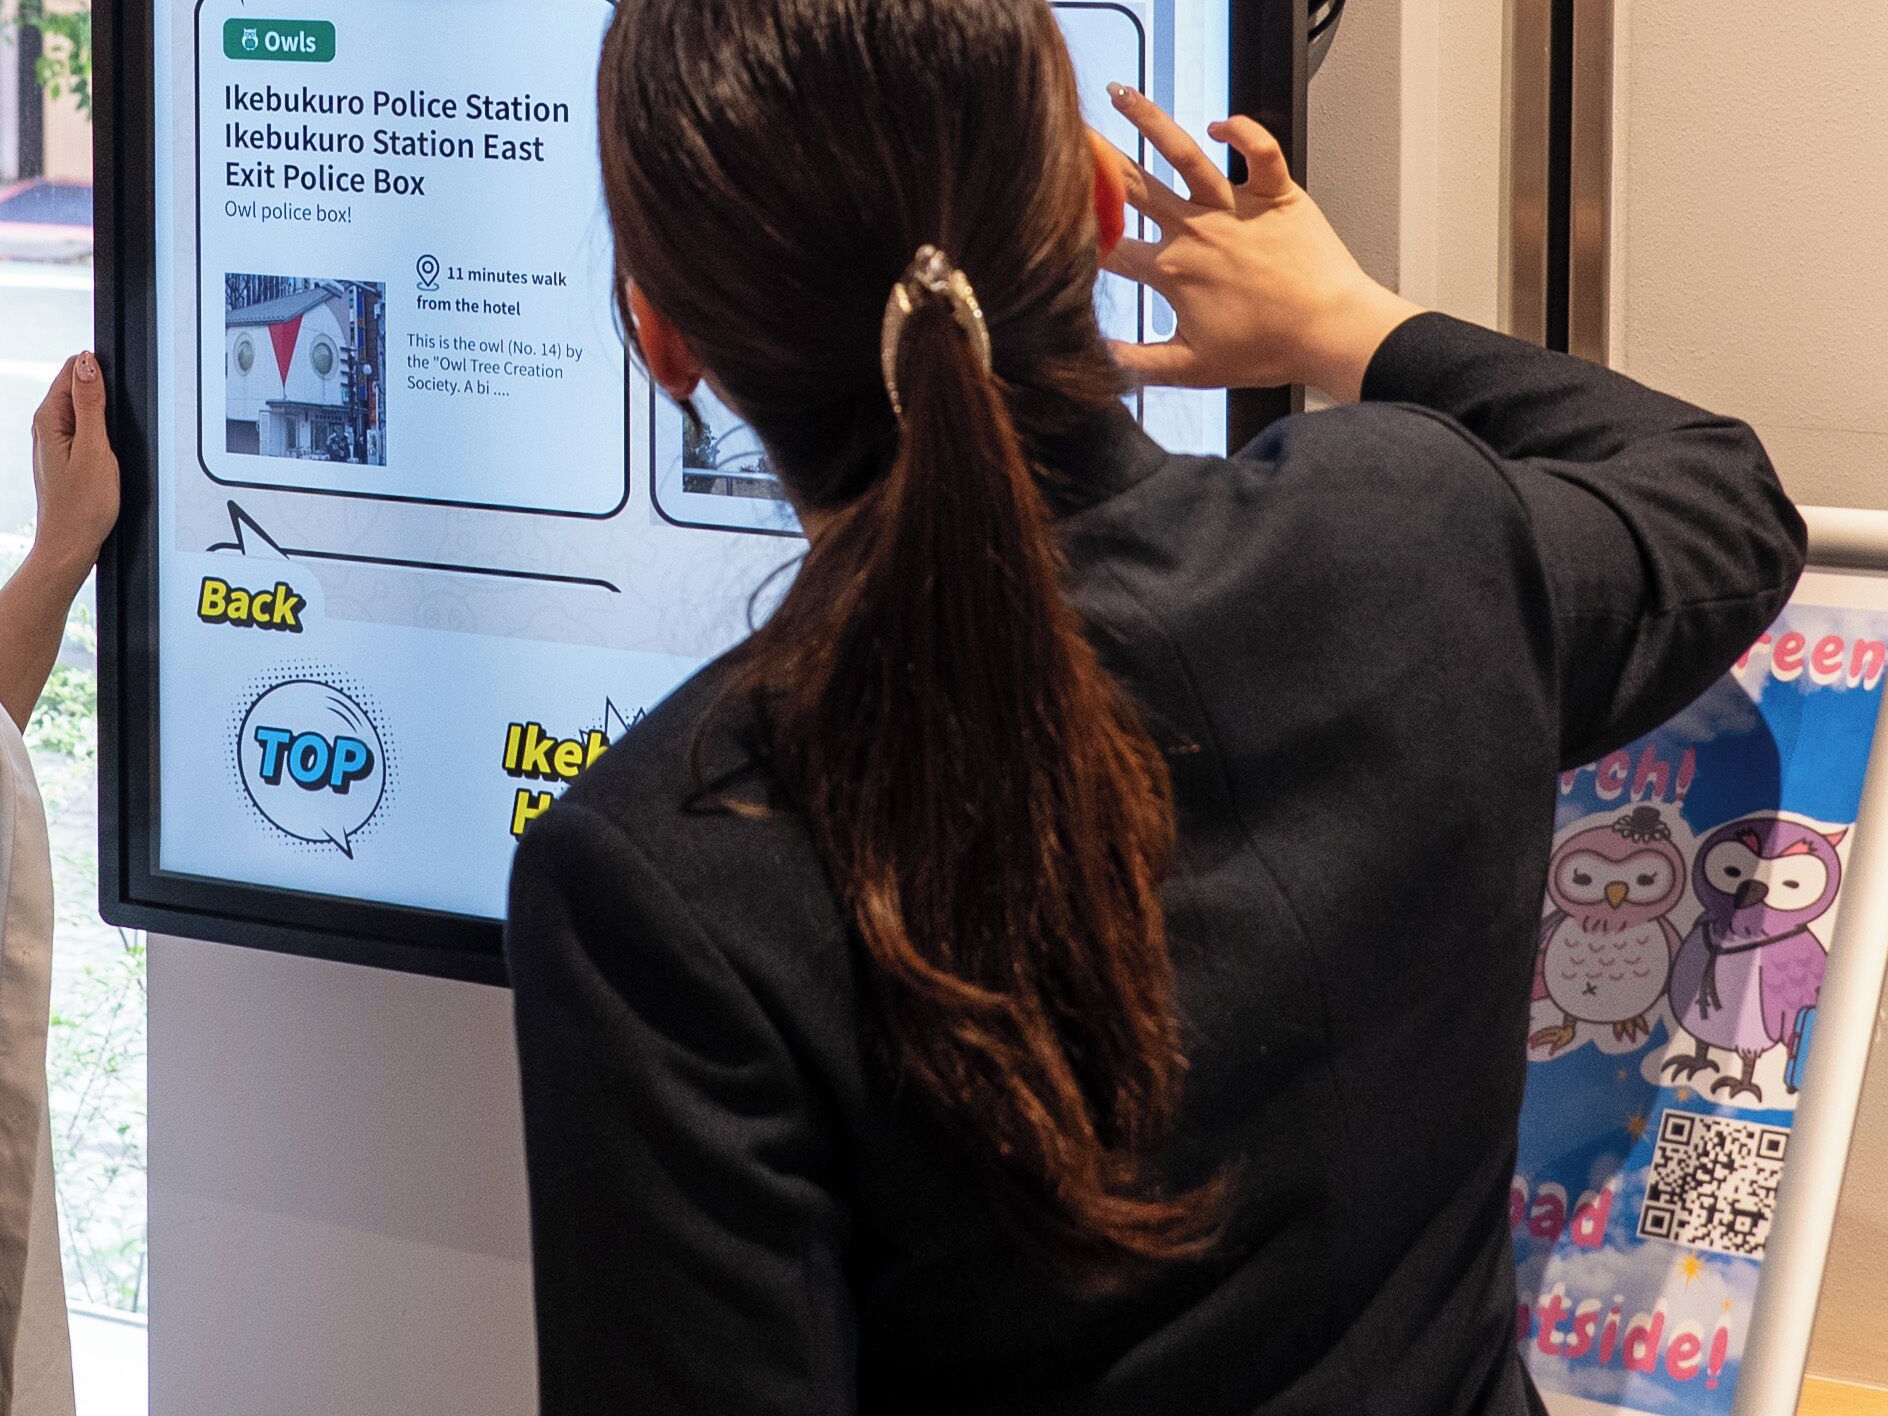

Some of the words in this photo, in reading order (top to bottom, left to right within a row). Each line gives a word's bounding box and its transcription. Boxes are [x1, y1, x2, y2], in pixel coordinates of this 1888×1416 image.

[264, 30, 316, 54] Owls
[225, 85, 365, 116] Ikebukuro
[373, 90, 458, 120] Police
[466, 94, 570, 123] Station
[225, 123, 365, 154] Ikebukuro
[373, 129, 474, 160] Station
[484, 134, 545, 163] East
[225, 161, 275, 190] Exit
[283, 165, 365, 194] Police
[374, 168, 425, 197] Box
[225, 199, 257, 219] Owl
[261, 201, 312, 225] police
[316, 203, 352, 224] box!
[447, 266, 464, 280] 11
[468, 266, 529, 284] minutes
[533, 270, 567, 287] walk
[416, 295, 451, 312] from
[455, 297, 480, 314] the
[483, 298, 521, 317] hotel
[407, 333, 435, 348] This
[439, 335, 449, 349] is
[454, 336, 476, 351] the
[479, 339, 504, 353] owl
[509, 339, 536, 357] (No.
[542, 343, 561, 359] 14)
[566, 344, 582, 361] by
[407, 355, 429, 369] the
[434, 356, 466, 372] "Owl
[470, 359, 500, 374] Tree
[504, 362, 563, 378] Creation
[407, 376, 460, 396] Society.
[464, 380, 473, 393] A
[478, 381, 489, 394] bi
[199, 578, 305, 631] Back
[254, 726, 373, 793] TOP
